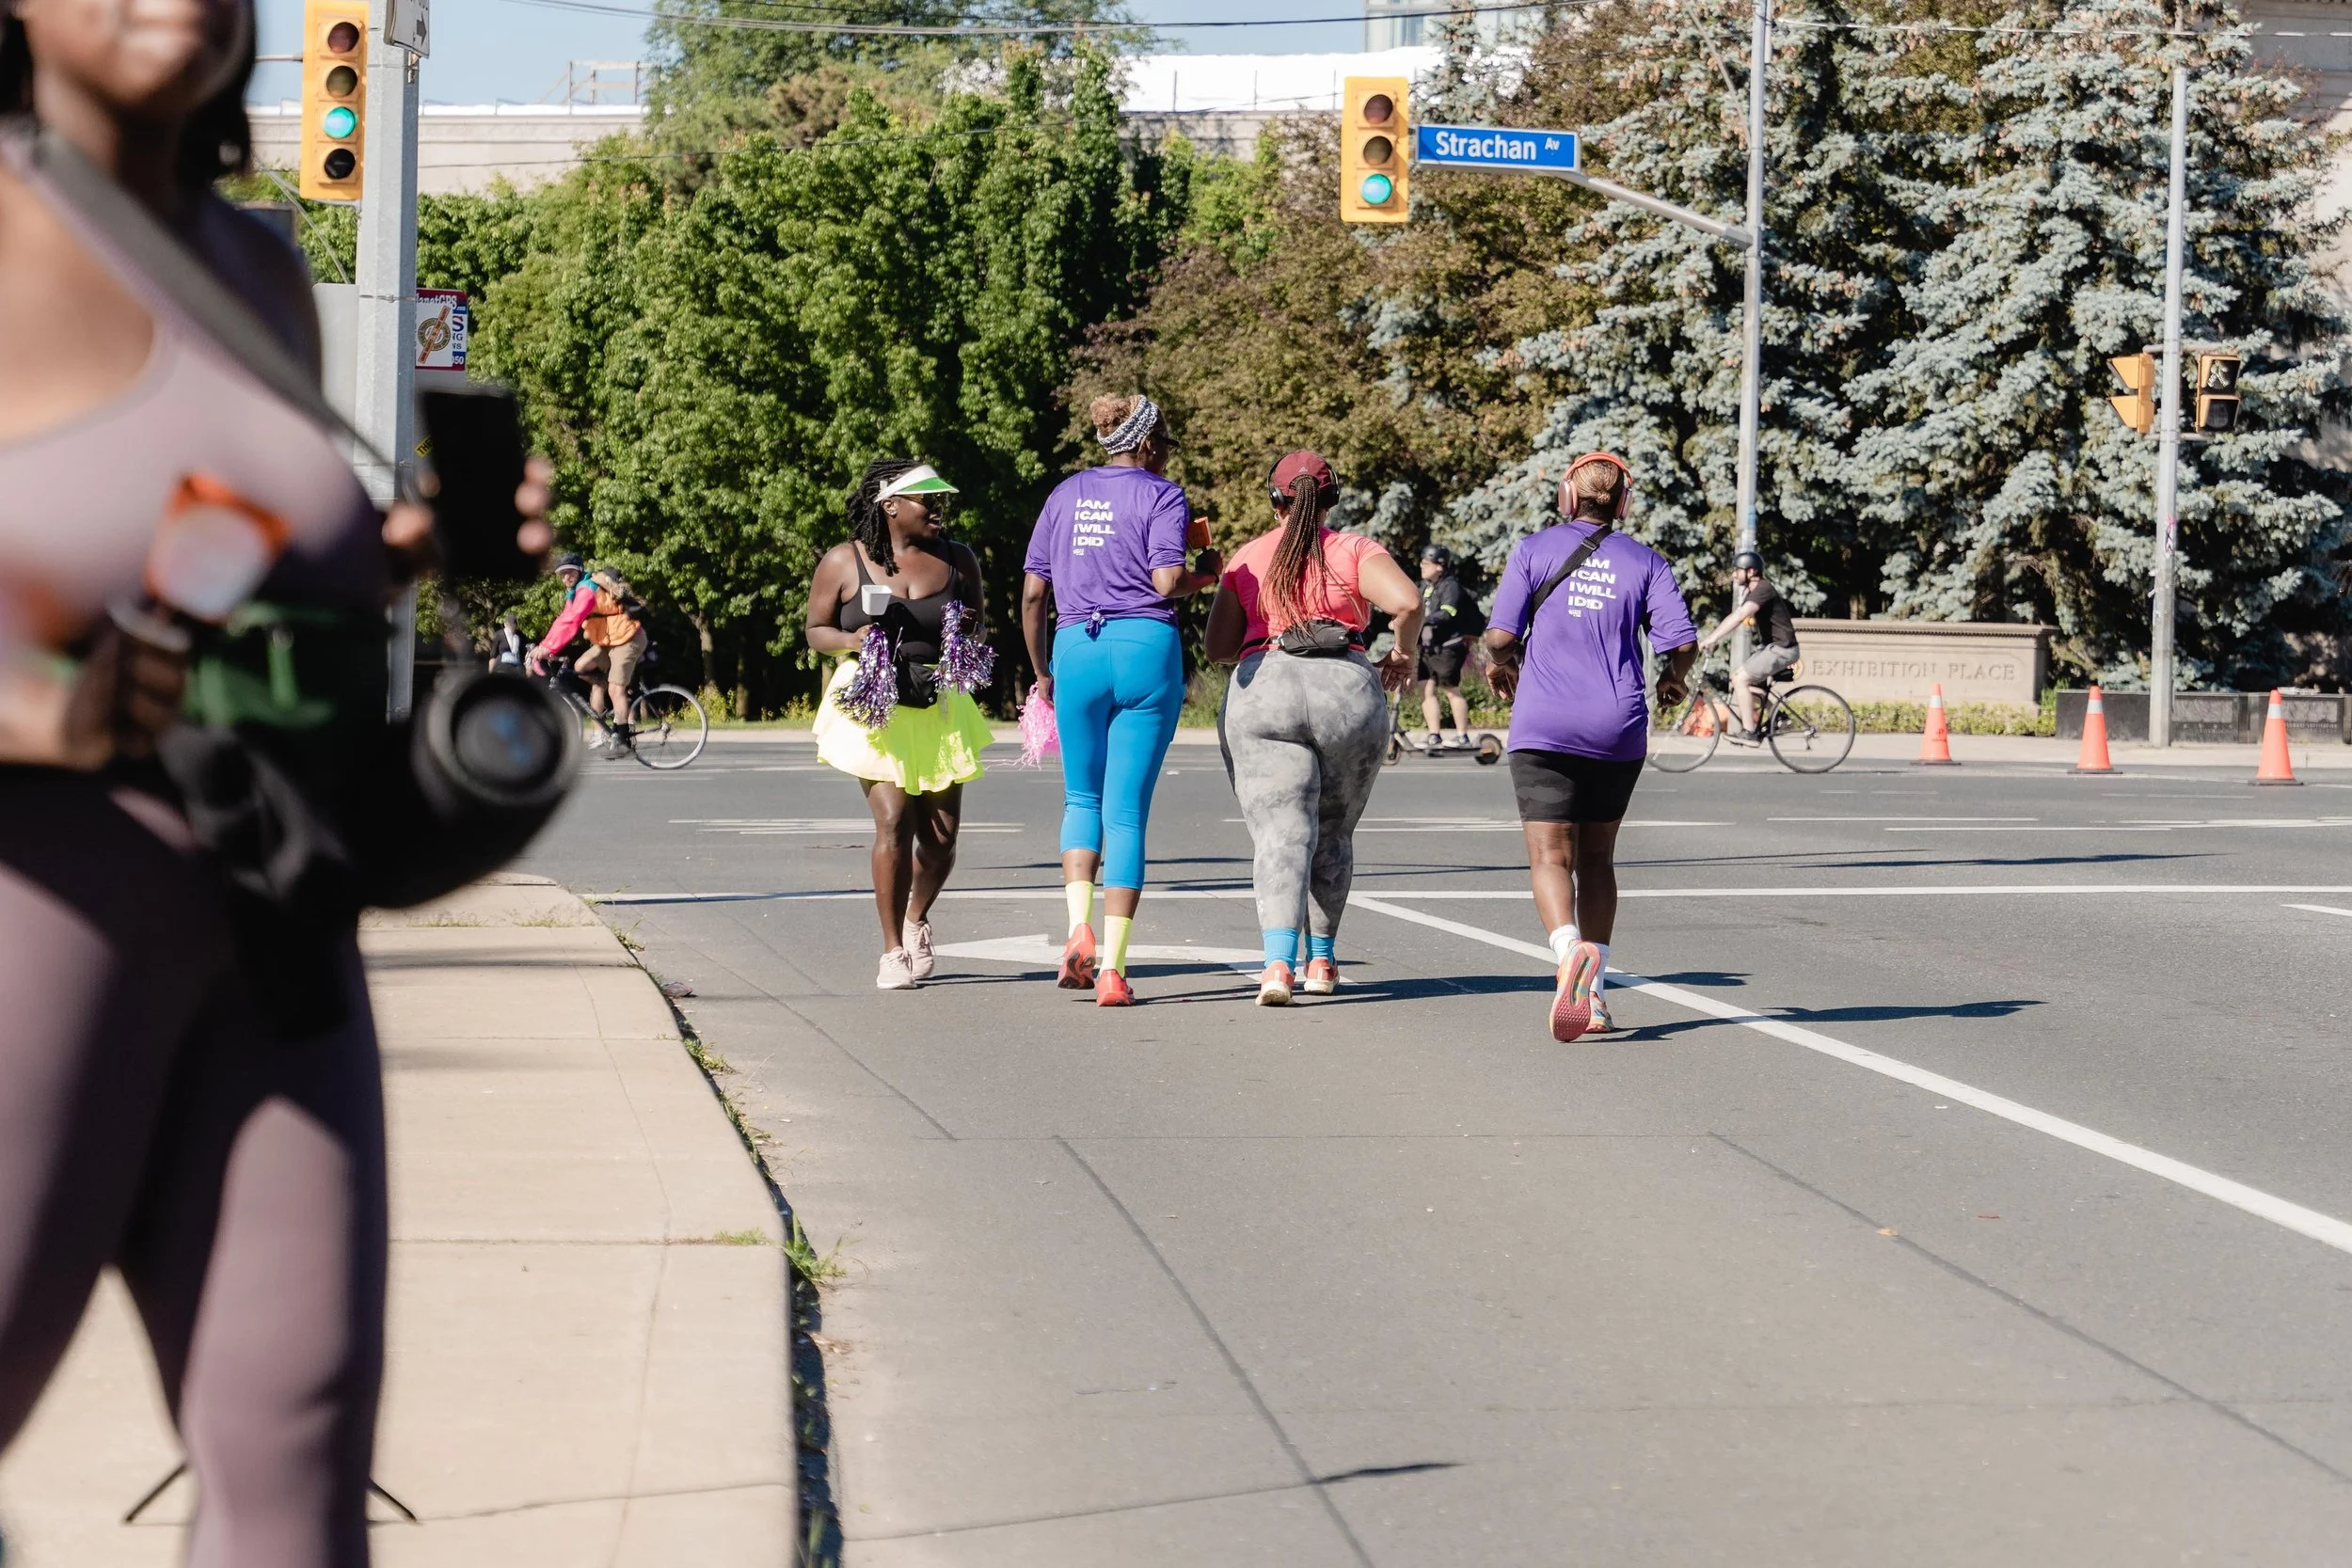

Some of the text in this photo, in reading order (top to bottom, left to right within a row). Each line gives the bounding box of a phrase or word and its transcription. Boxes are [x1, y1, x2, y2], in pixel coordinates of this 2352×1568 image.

[1436, 131, 1561, 161] Strachan Av
[1081, 499, 1111, 510] AM
[1079, 511, 1114, 521] CAN
[1078, 524, 1116, 534] WILL
[1077, 536, 1104, 546] DID
[1578, 570, 1616, 584] CAN
[1576, 582, 1616, 599] WILL
[1574, 596, 1603, 610] DID
[1812, 660, 2015, 680] EXHIBITION PLACE
